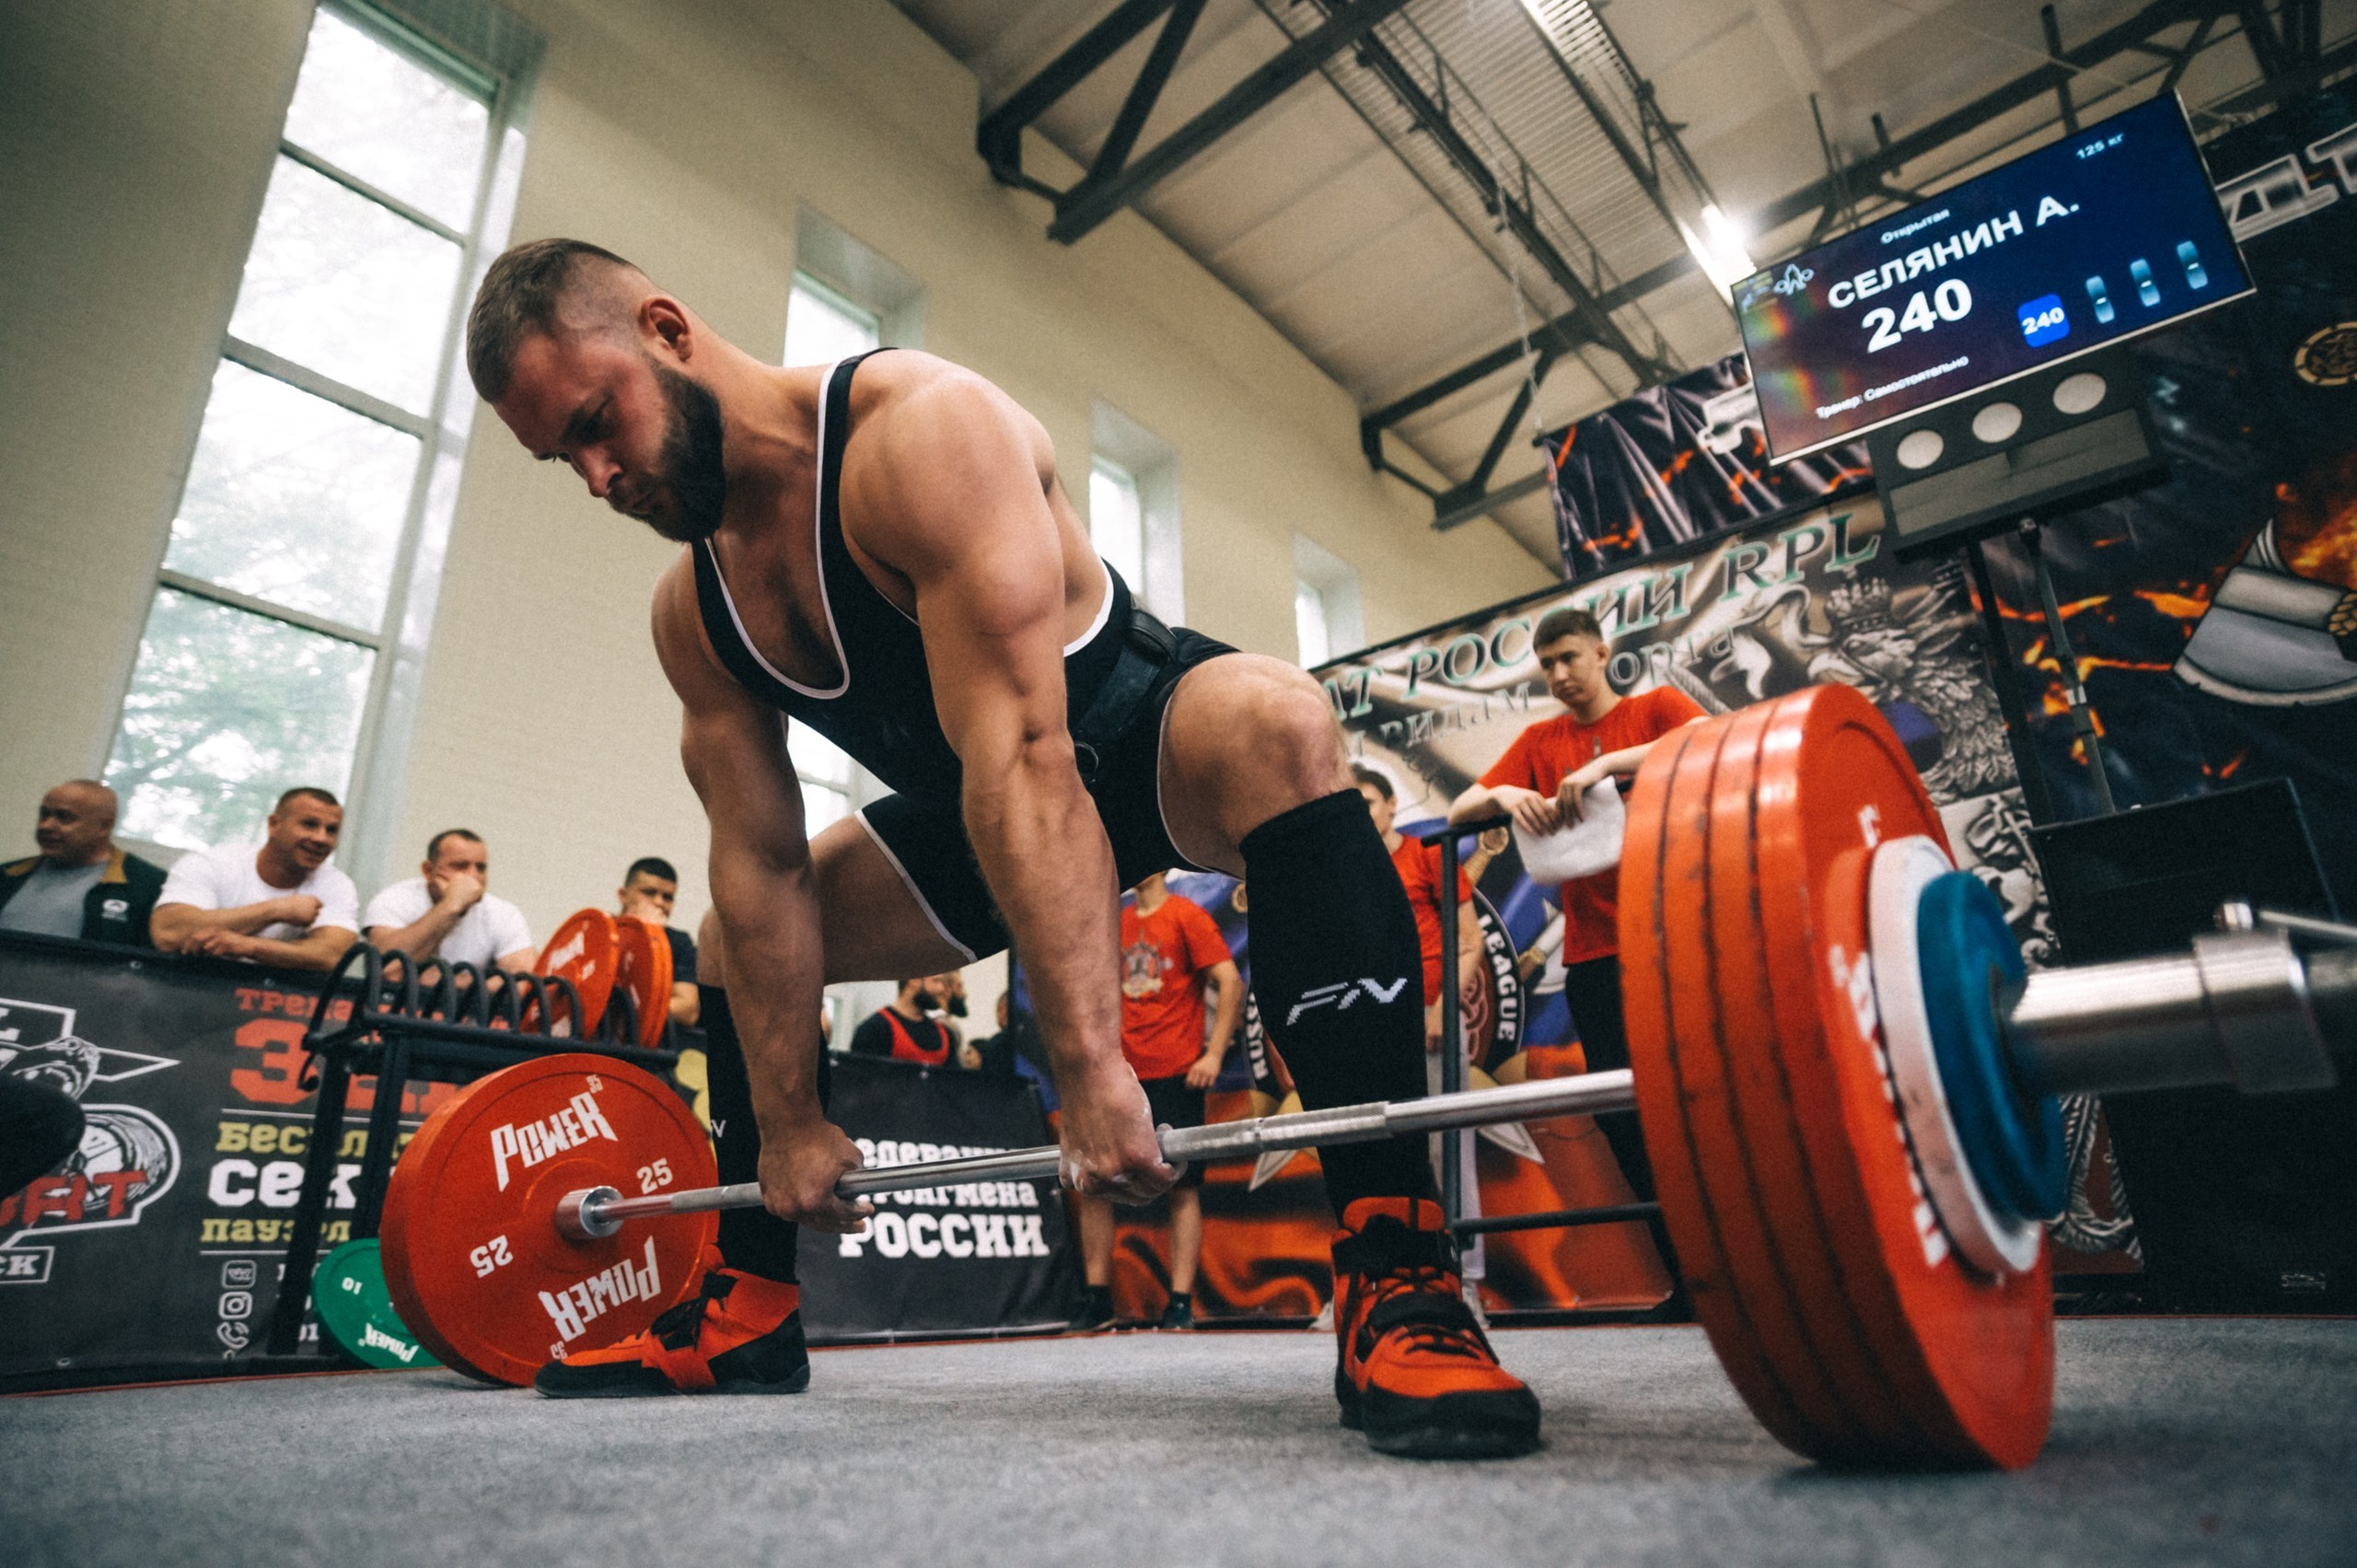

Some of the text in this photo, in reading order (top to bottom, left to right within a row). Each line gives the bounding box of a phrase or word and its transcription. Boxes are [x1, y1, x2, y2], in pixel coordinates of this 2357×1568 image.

[2075, 132, 2126, 159] 125 кг
[1880, 209, 1950, 244] Открытая
[1828, 195, 2080, 308] СЕЛЯНИН А.
[1862, 278, 1972, 354] 240
[2021, 307, 2065, 335] 240
[1400, 563, 1694, 703] РОСИИ
[1718, 510, 1881, 603] RPL
[1479, 913, 1517, 1042] LEAGUE
[490, 1090, 619, 1193] POWER
[636, 1157, 674, 1194] 25
[470, 1235, 515, 1279] 25
[839, 1212, 1051, 1258] РОССИИ
[342, 1276, 363, 1295] 10
[538, 1235, 662, 1343] POWER
[365, 1321, 420, 1364] POWER
